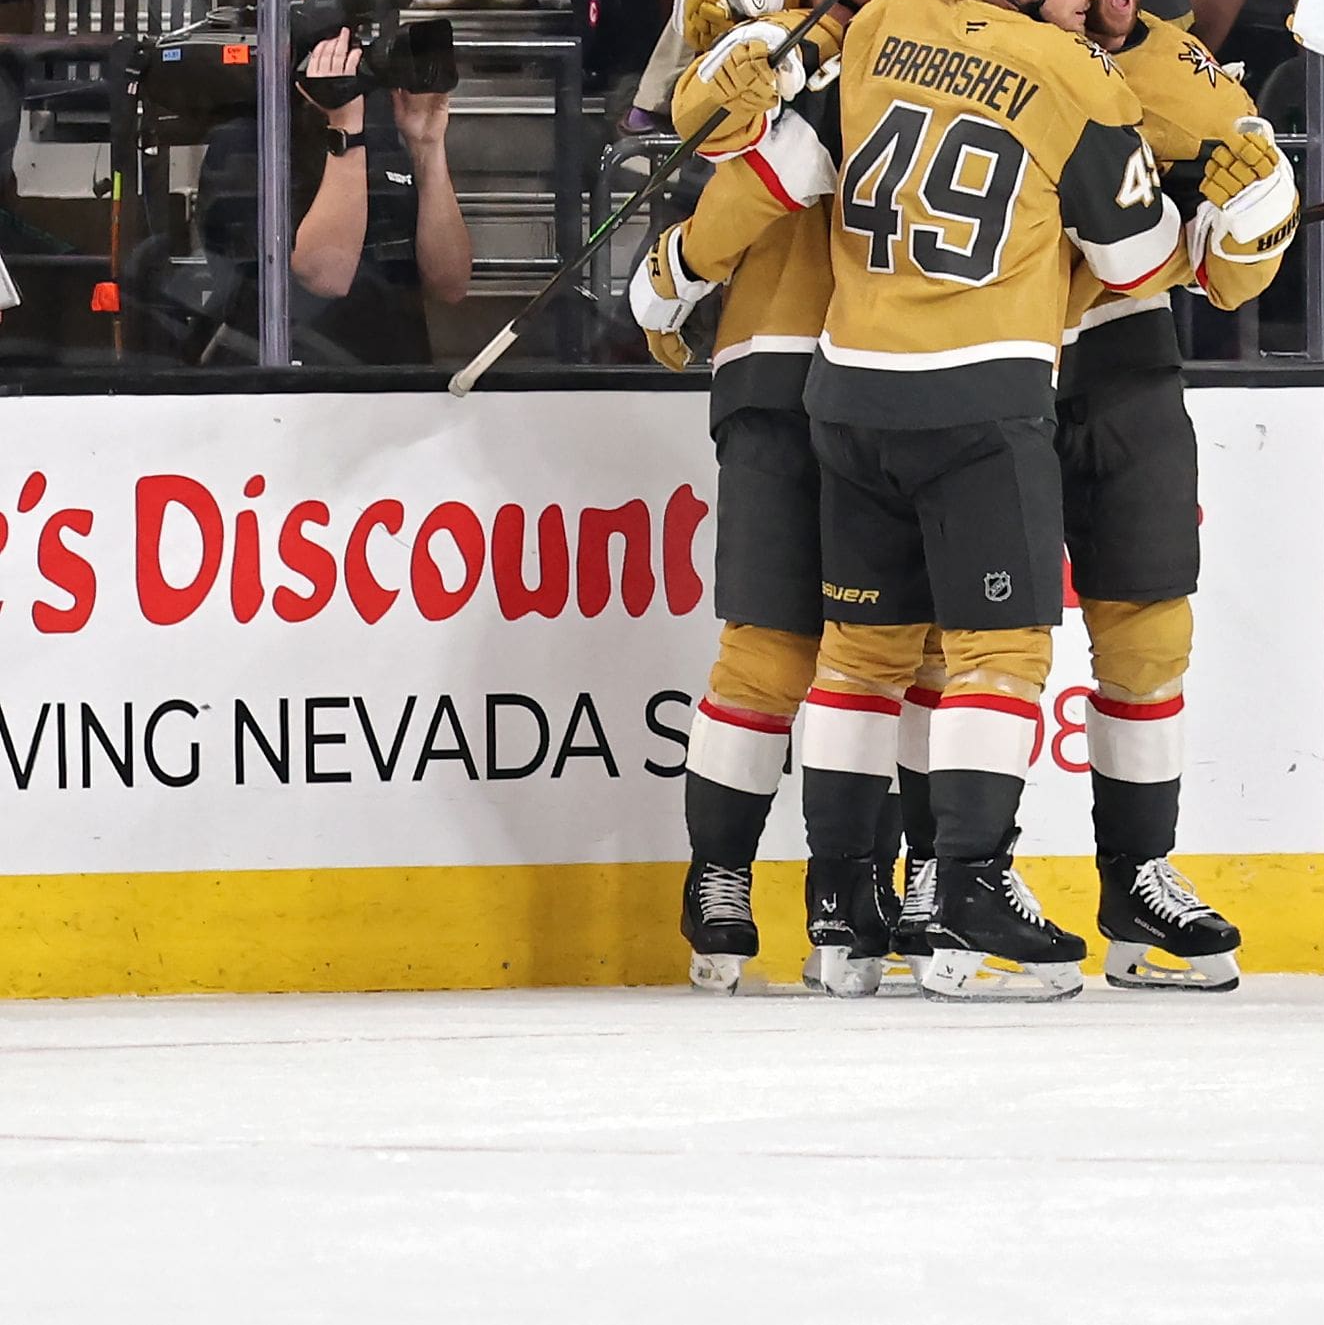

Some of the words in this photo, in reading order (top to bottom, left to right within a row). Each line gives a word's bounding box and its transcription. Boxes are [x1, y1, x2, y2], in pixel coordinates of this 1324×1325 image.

[873, 35, 1039, 122] BARBASHEV
[839, 98, 1030, 288] 49
[0, 470, 97, 634] 's
[135, 473, 709, 626] Discount
[234, 692, 621, 785] NEVADA
